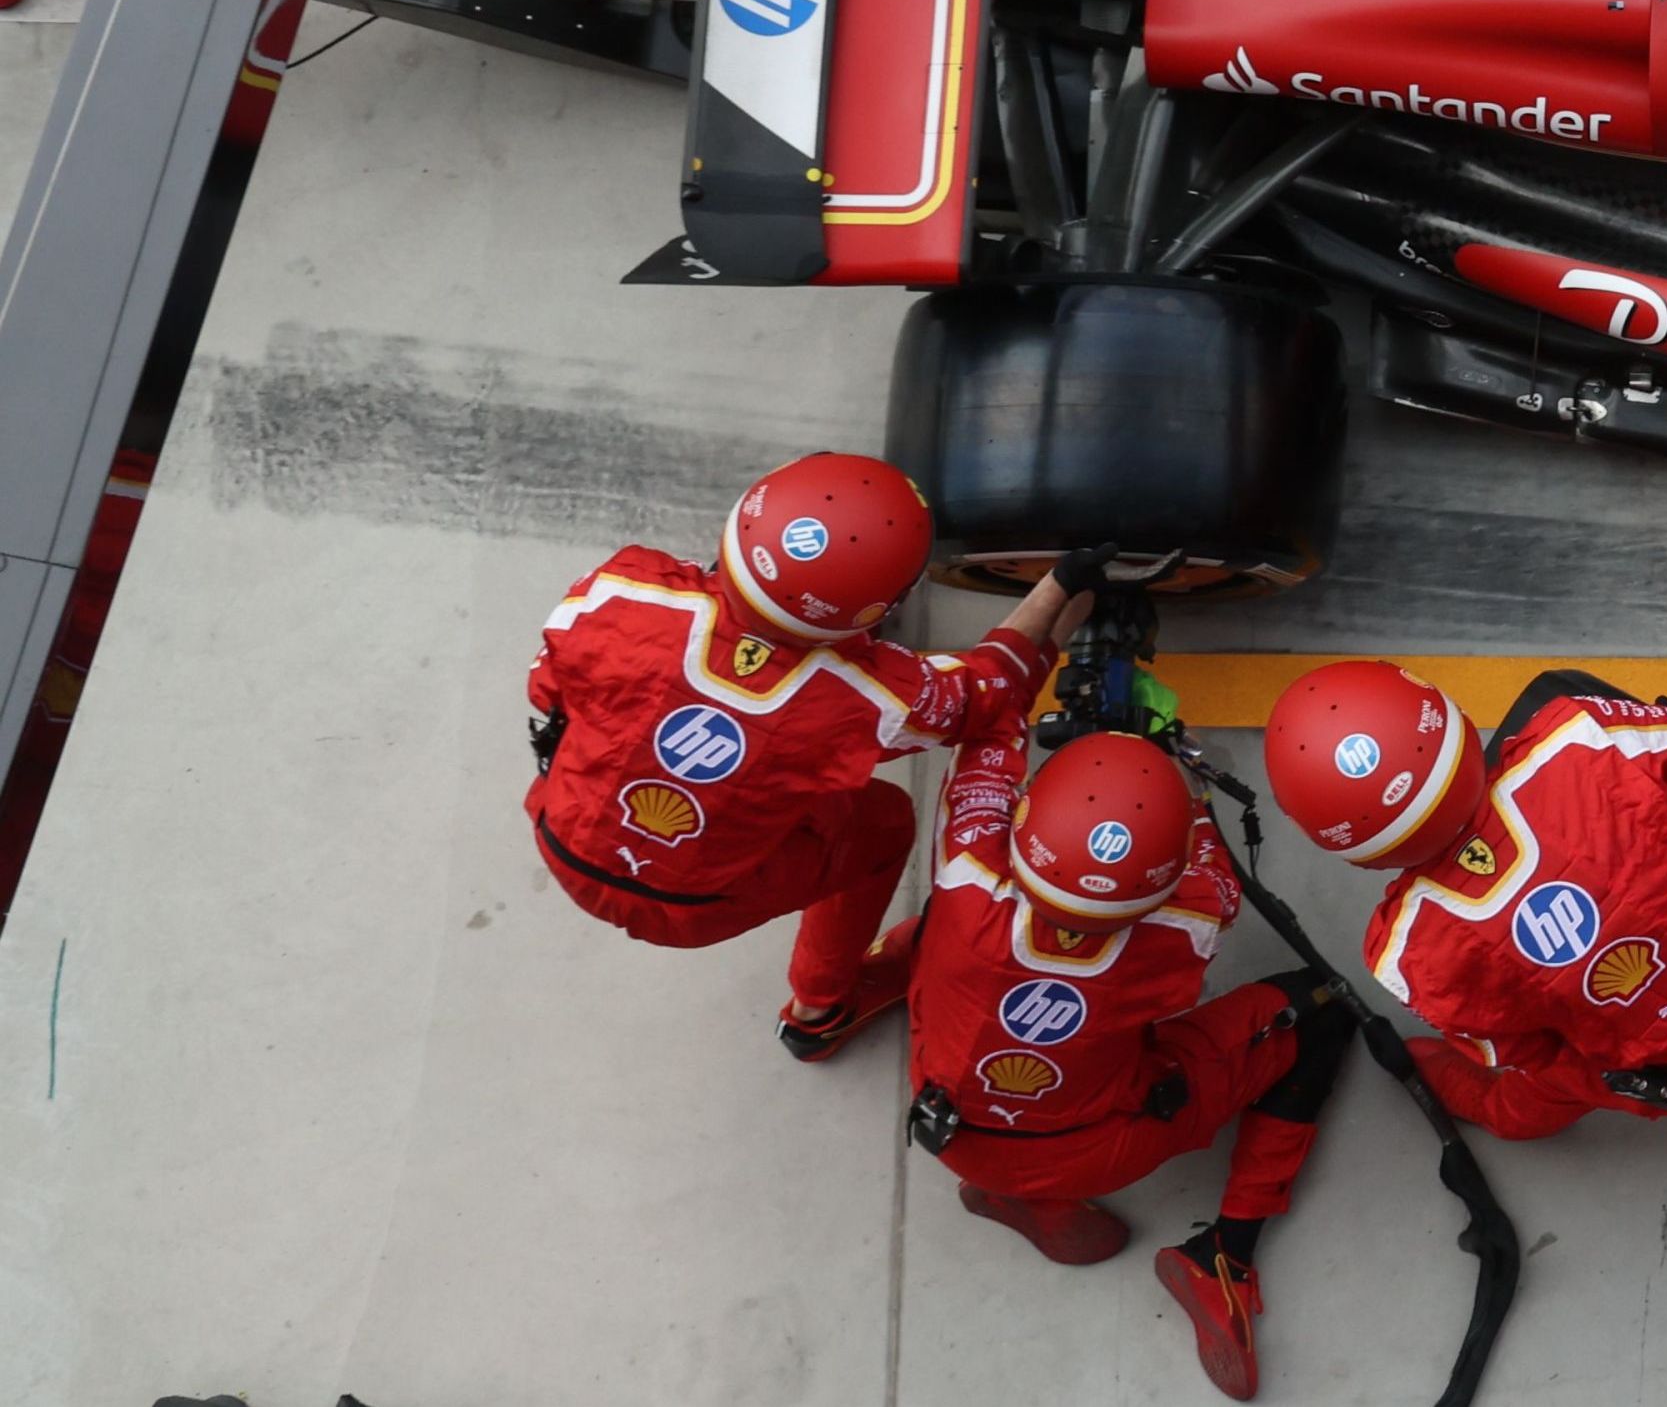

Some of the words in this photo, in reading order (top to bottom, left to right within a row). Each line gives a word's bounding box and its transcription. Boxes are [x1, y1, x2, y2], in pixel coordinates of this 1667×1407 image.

[1291, 72, 1611, 141] Santander
[786, 519, 826, 559] hp
[662, 707, 738, 780] hp
[1341, 735, 1376, 776] hp
[1093, 823, 1128, 862] hp
[1524, 884, 1590, 962] hp
[1007, 981, 1081, 1043] hp
